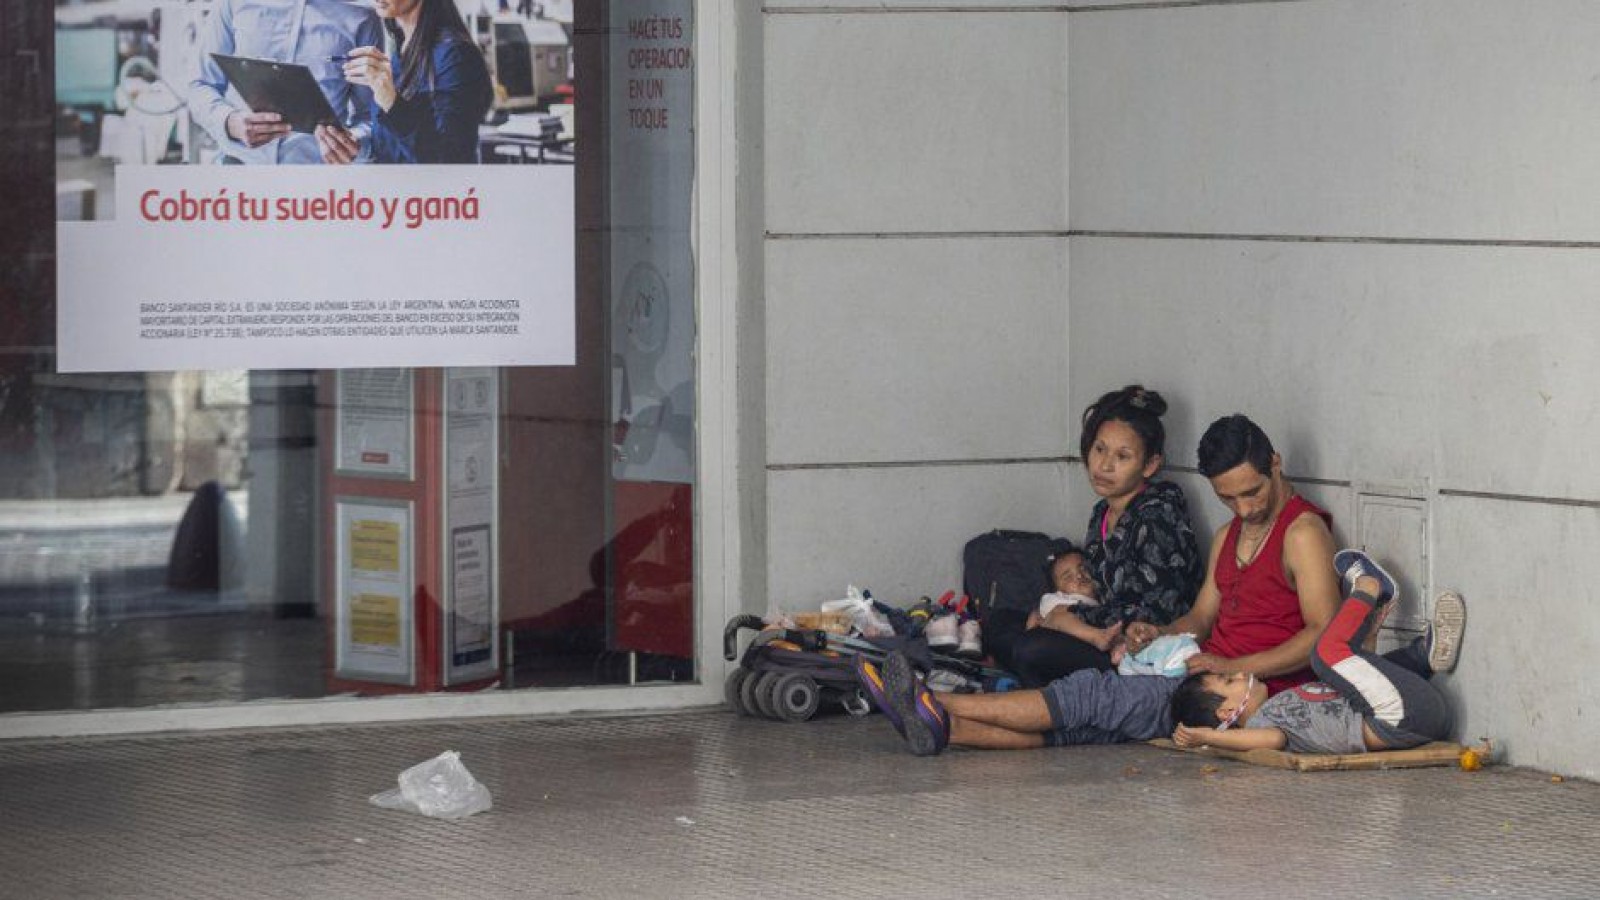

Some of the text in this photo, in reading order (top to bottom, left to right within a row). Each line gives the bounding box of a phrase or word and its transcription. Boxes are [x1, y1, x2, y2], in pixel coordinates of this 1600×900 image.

[659, 17, 682, 39] TUS
[628, 79, 663, 99] EN UN
[628, 108, 668, 130] TOQUE
[140, 187, 480, 229] Cobrá tu sueldo y ganá
[140, 302, 166, 312] BANCO
[167, 301, 212, 312] SANTANDER
[275, 301, 311, 311] SOCIEDAD
[478, 299, 520, 309] ACCIONISTA
